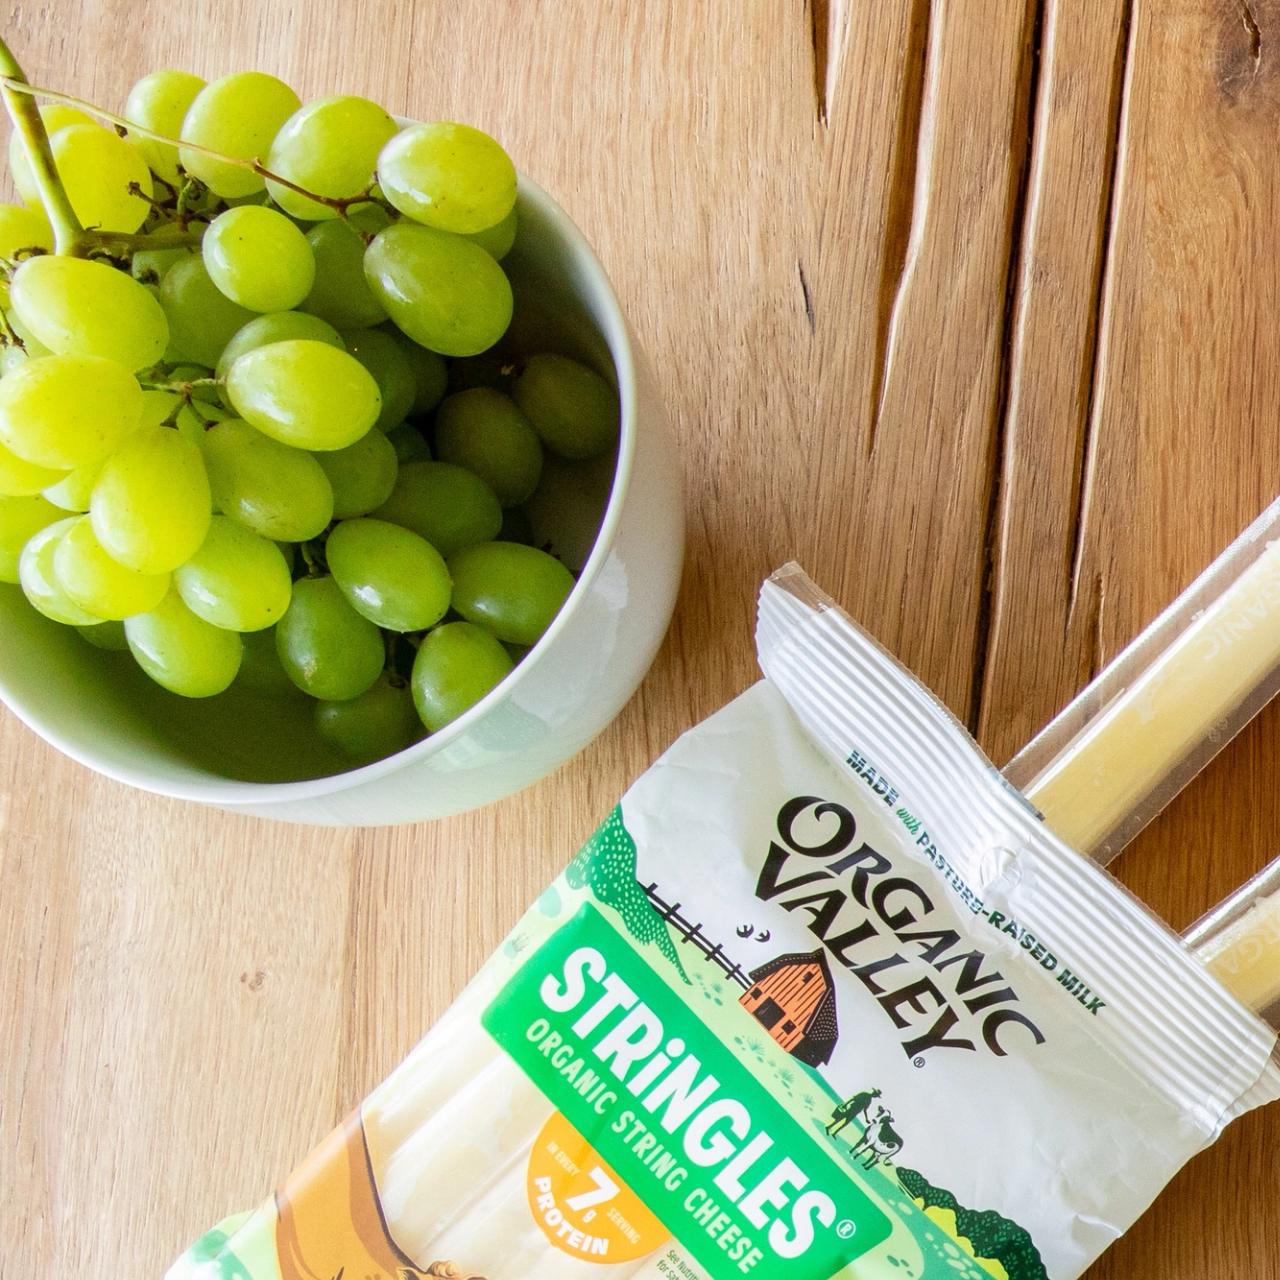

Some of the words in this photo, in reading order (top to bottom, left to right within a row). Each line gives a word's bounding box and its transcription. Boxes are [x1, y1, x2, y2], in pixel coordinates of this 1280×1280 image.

[844, 750, 900, 807] MADE
[894, 804, 924, 836] with
[914, 831, 1060, 974] PASTURE-RAISED
[1056, 968, 1107, 1017] MILK
[777, 797, 1046, 1058] ORGANIC
[522, 1014, 618, 1117] ORGANIC
[610, 1108, 690, 1194] STRING
[681, 1186, 764, 1276] CHEESE
[545, 1140, 559, 1156] IN
[552, 1149, 581, 1179] EVERY
[532, 1175, 610, 1254] PROTEIN
[605, 1206, 641, 1245] SERVING
[654, 1258, 670, 1275] for
[665, 1248, 680, 1265] See
